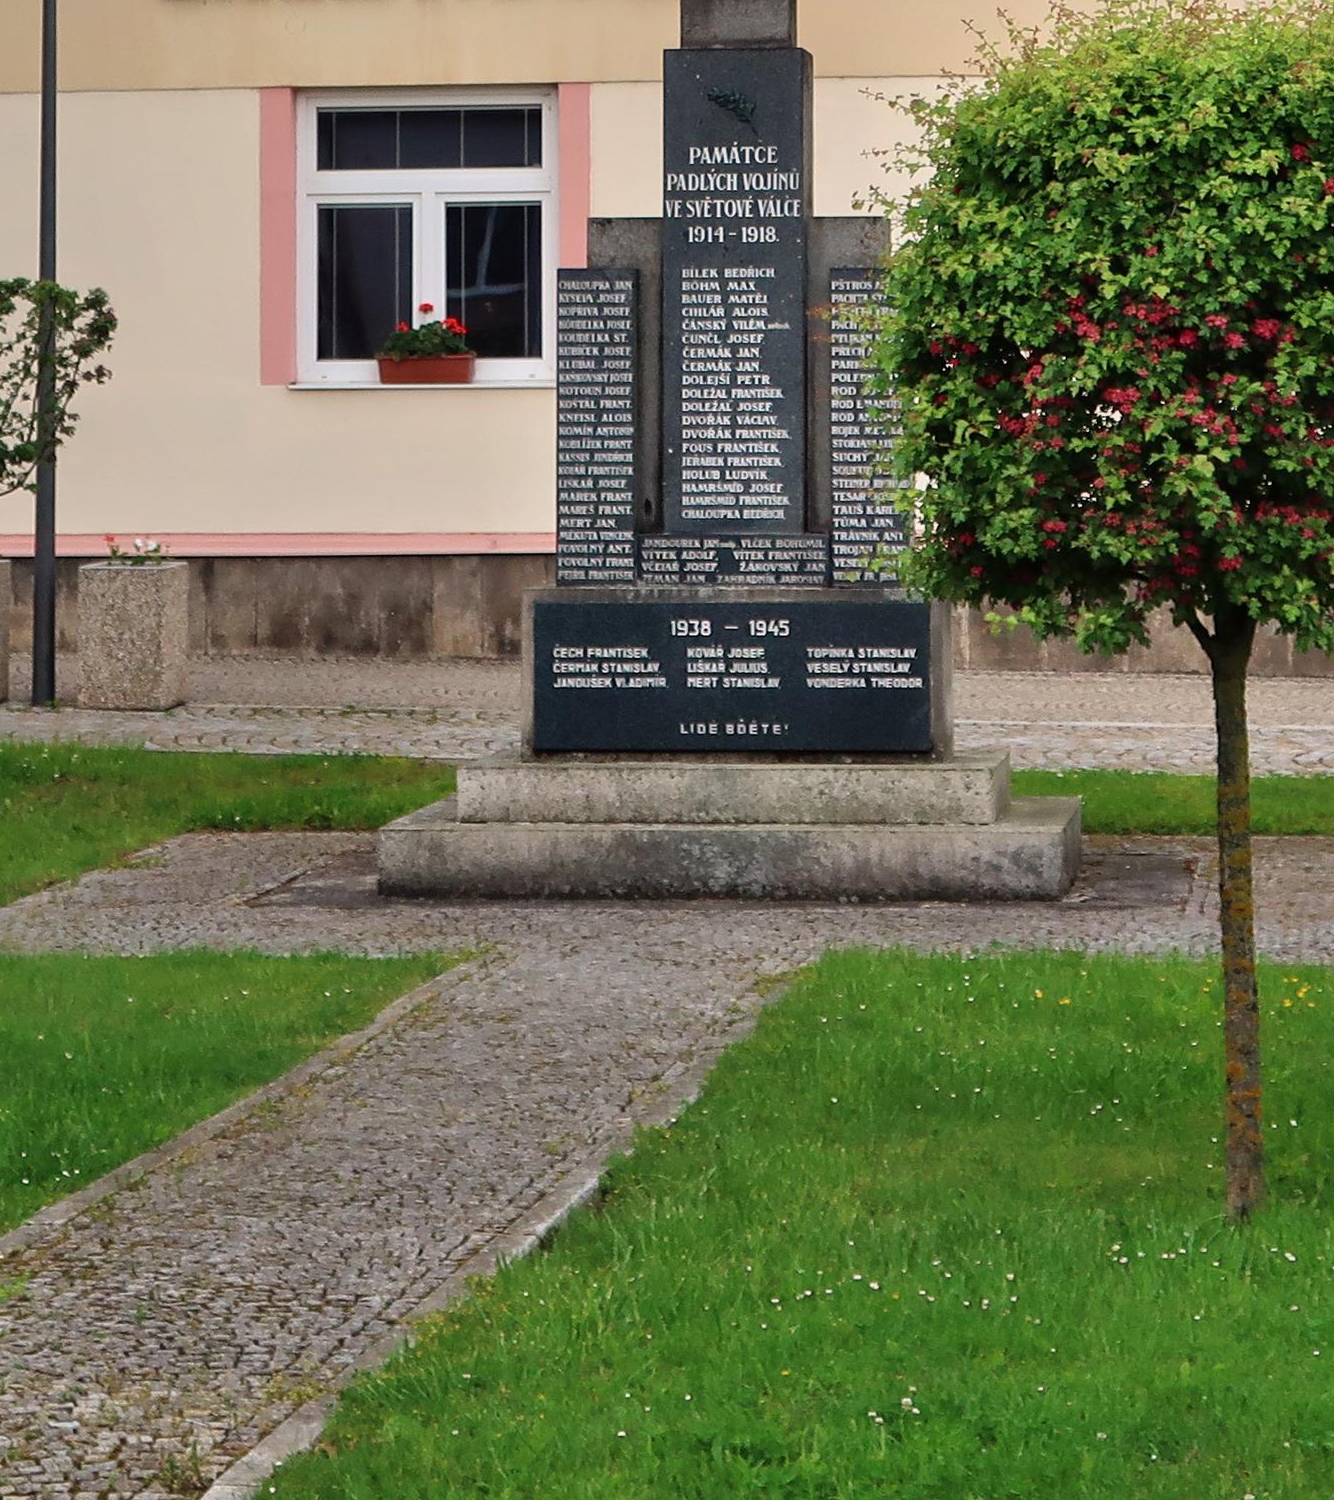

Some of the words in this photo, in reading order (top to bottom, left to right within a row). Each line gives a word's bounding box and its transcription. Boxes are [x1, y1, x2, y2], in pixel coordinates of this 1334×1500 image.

[666, 168, 738, 191] PADLÝCH
[665, 199, 683, 218] VE
[685, 195, 755, 218] SVĚTOVÉ
[687, 225, 725, 243] 1914
[741, 225, 780, 243] 1918.
[727, 281, 755, 291] MAX
[682, 294, 722, 303] BAUER
[682, 346, 732, 358] ČERMÁK
[682, 359, 732, 371] ČERMÁK
[682, 469, 720, 480] HOLUB
[670, 620, 712, 637] 1938
[748, 620, 790, 637] 1945
[552, 644, 584, 659] ČECH
[687, 677, 719, 688] MERT
